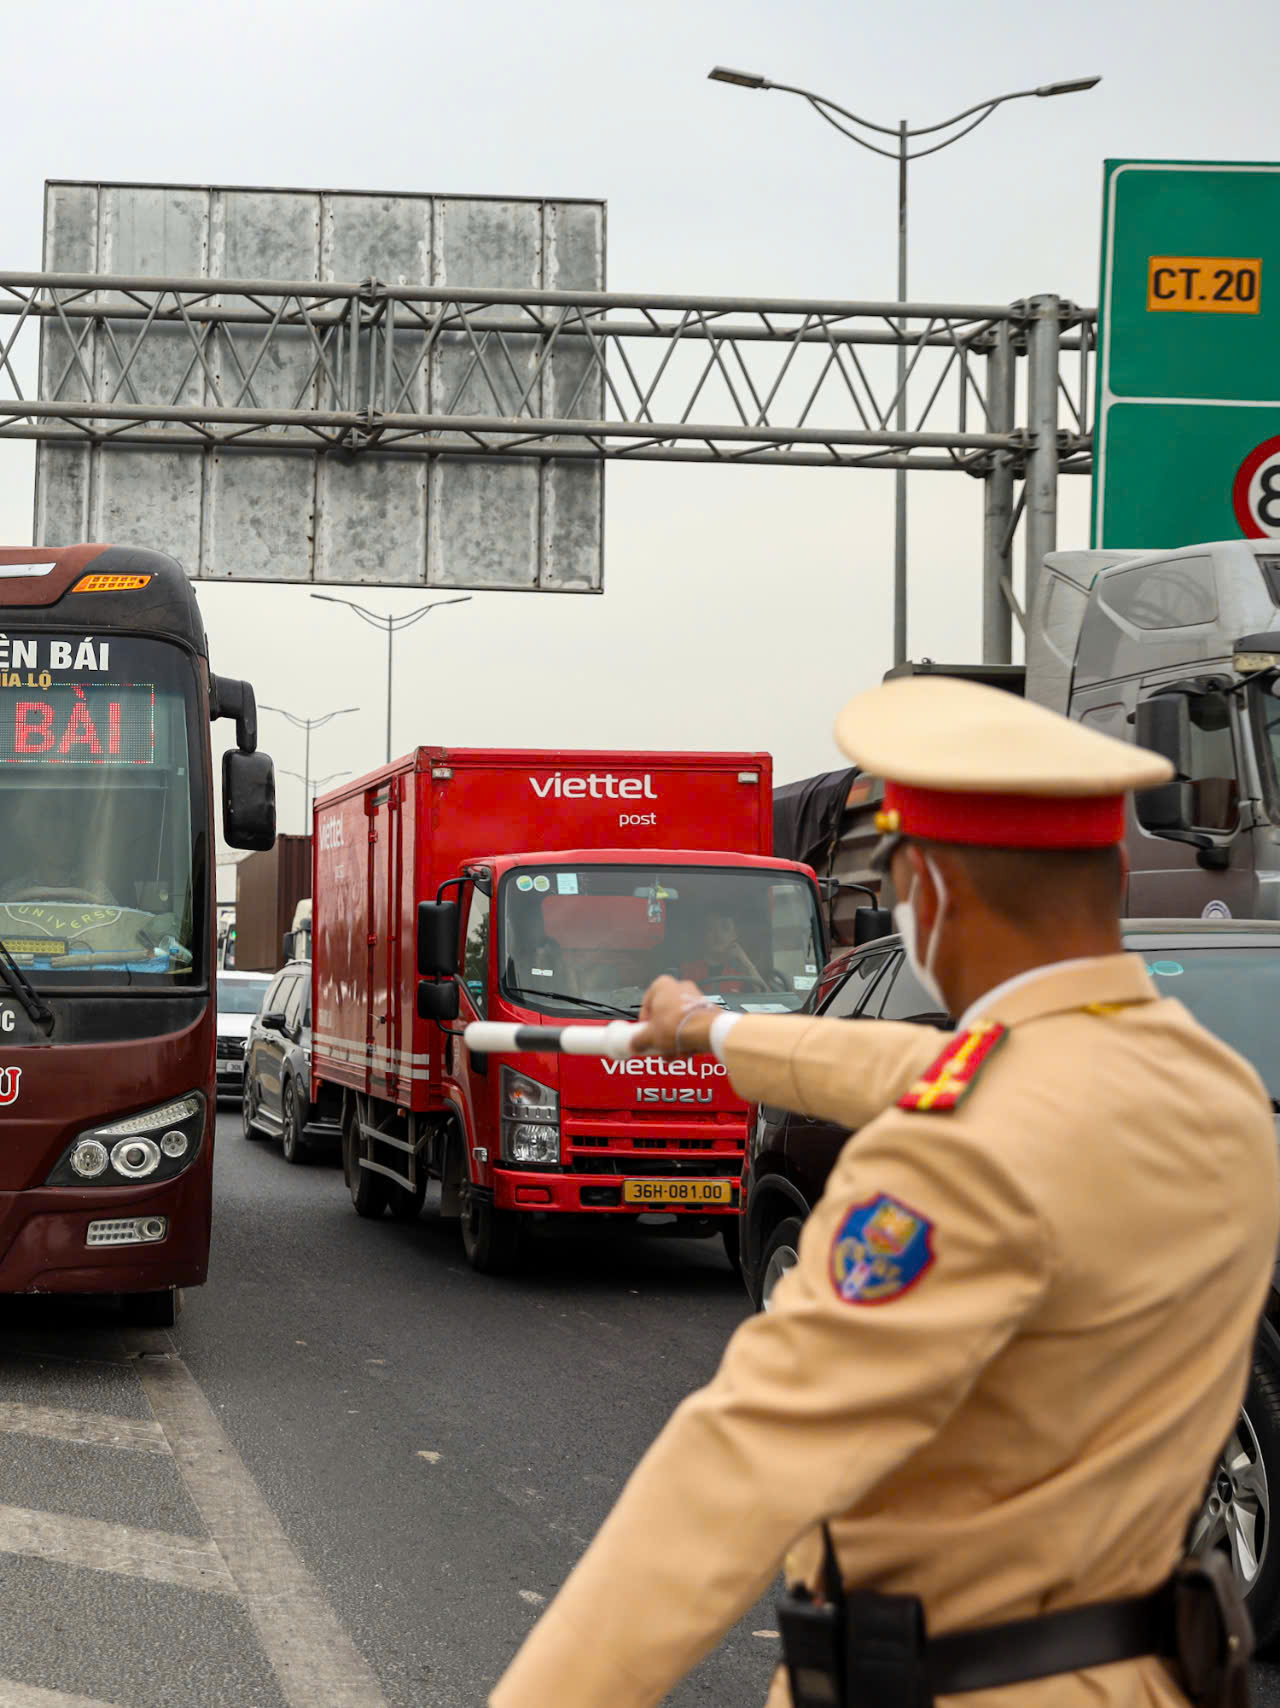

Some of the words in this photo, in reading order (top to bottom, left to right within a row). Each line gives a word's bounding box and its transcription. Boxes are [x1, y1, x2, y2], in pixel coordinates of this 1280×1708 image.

[1152, 267, 1256, 303] CT.20
[50, 636, 109, 671] BÁI
[27, 669, 52, 691] LỘ
[14, 684, 121, 754] BÀI
[528, 772, 658, 799] viettel
[619, 812, 657, 828] post
[18, 905, 116, 930] UNIVERSE
[601, 1056, 698, 1076] viettel
[636, 1087, 713, 1103] ISUZU
